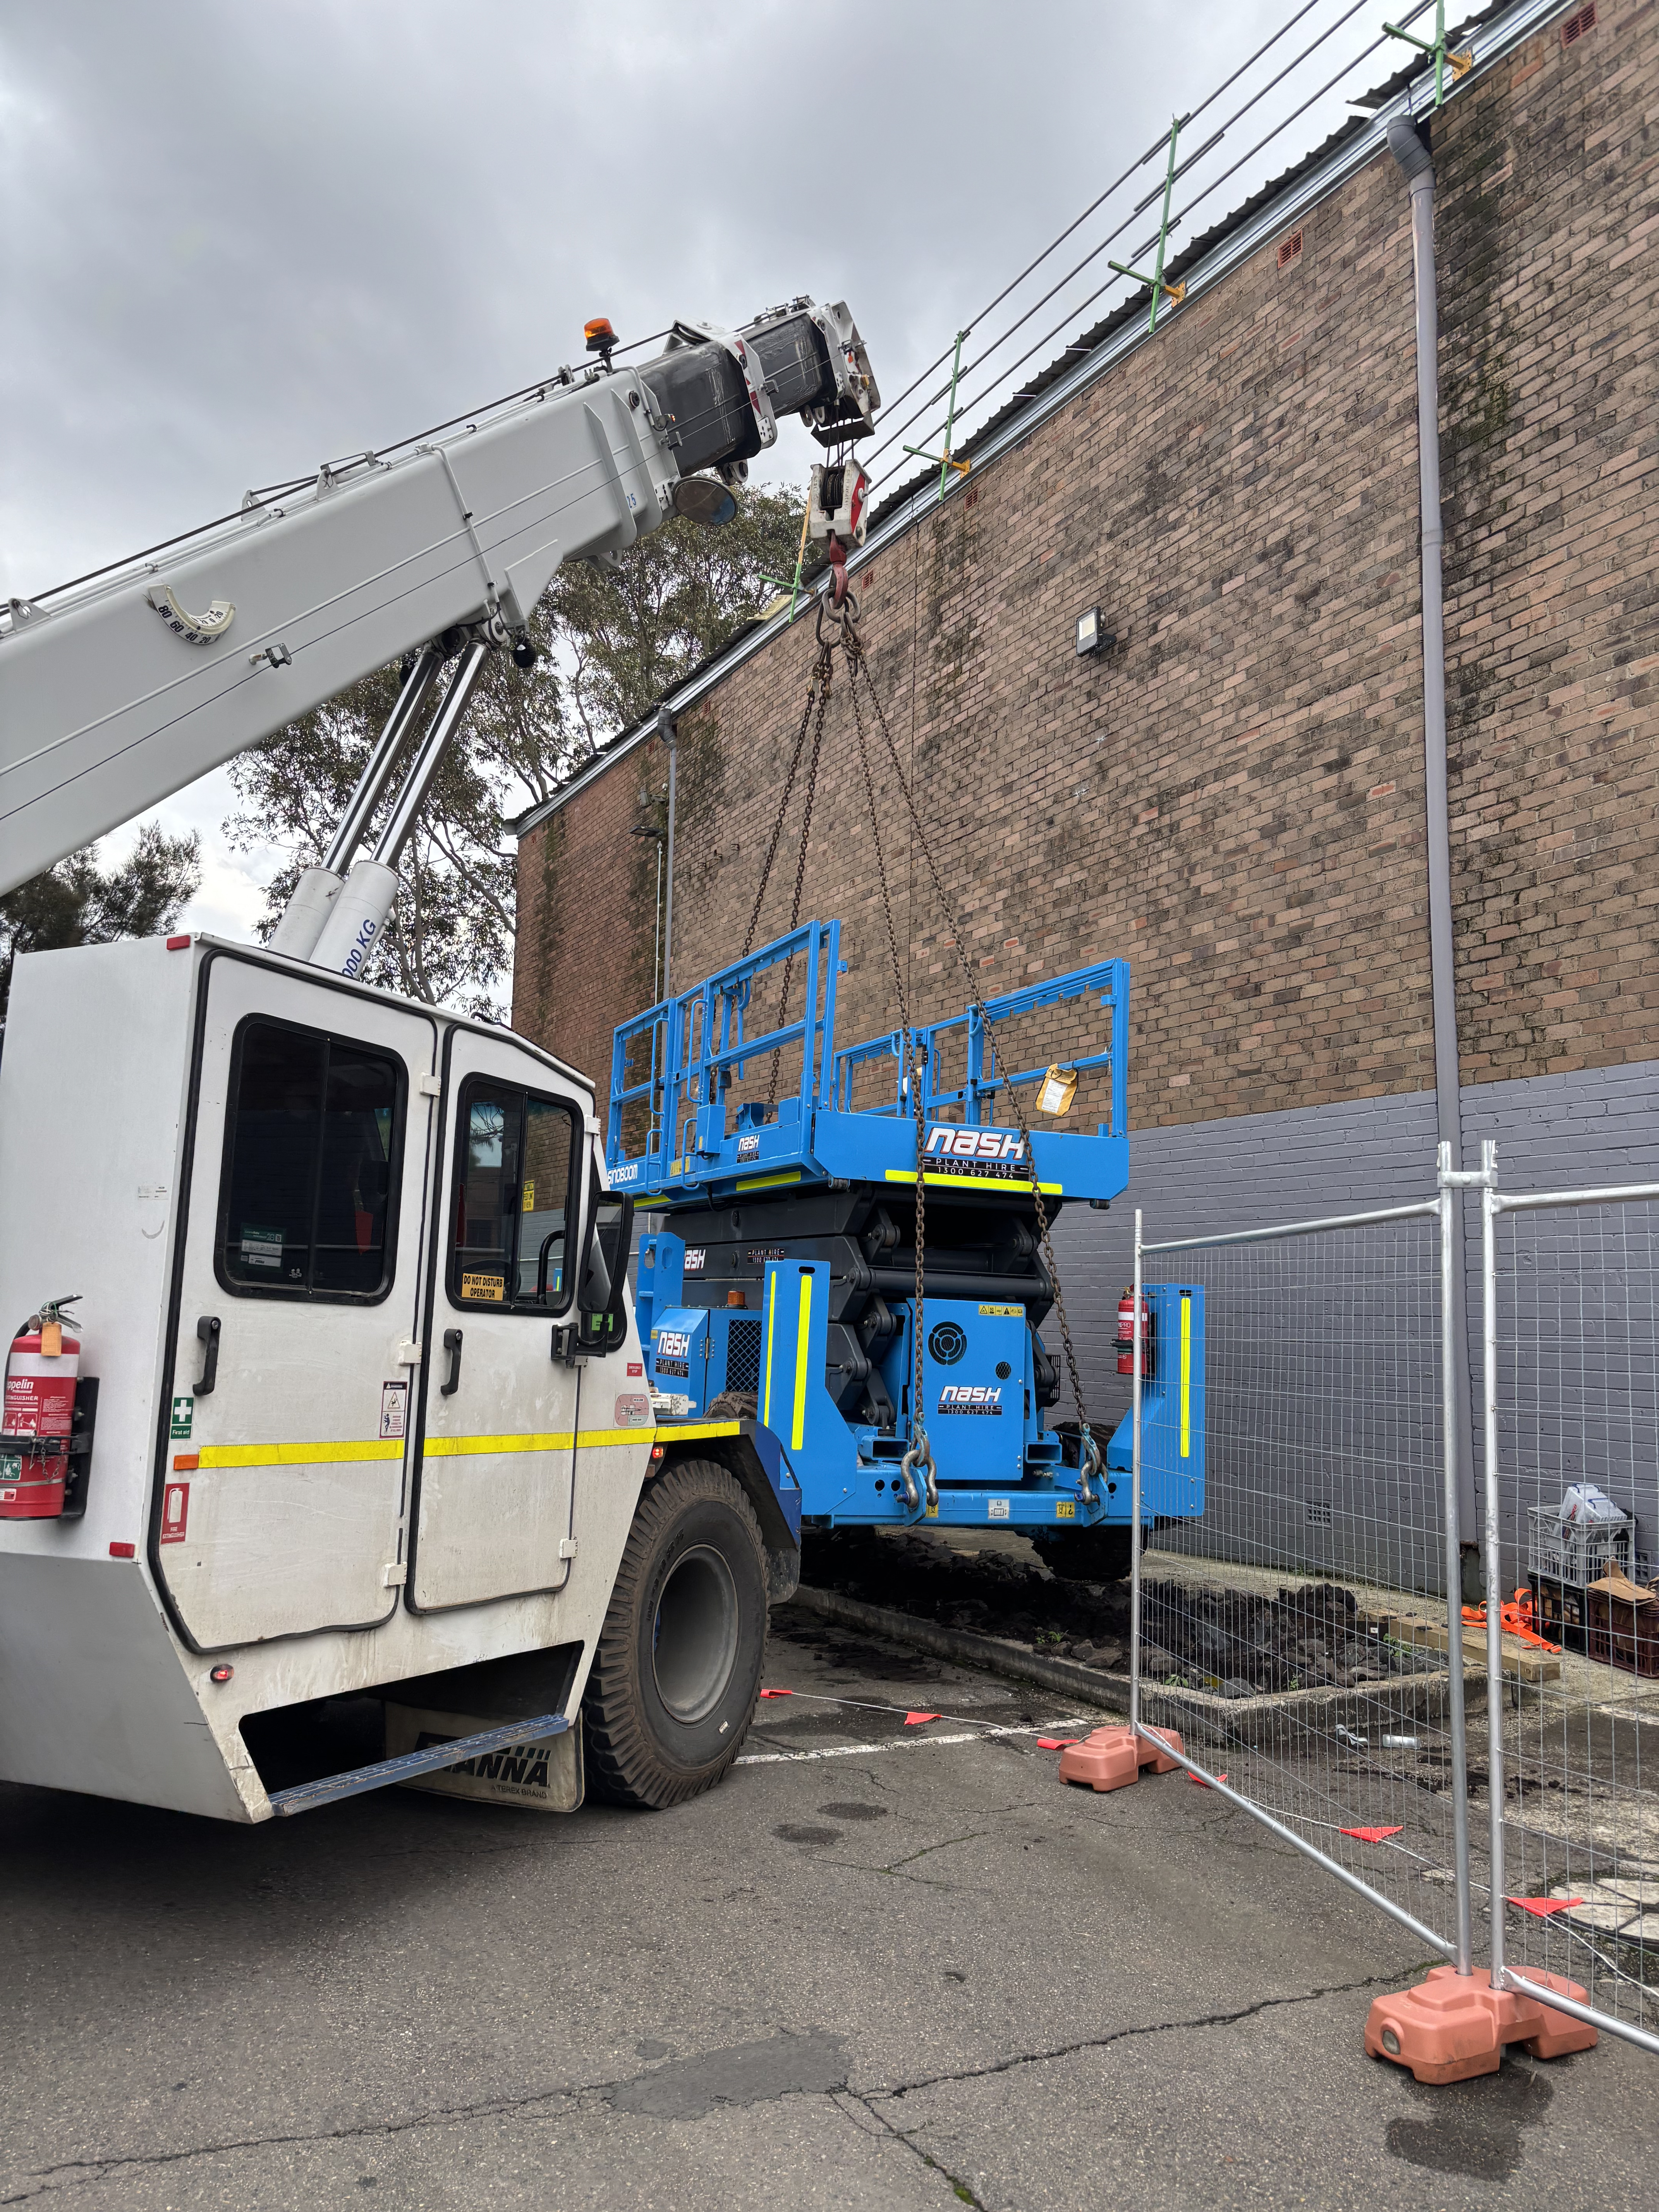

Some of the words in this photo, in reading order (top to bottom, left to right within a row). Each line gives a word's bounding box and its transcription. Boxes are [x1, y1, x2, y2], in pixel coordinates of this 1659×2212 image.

[158, 605, 172, 618] 80
[170, 620, 185, 632] 60
[185, 632, 199, 641] 40
[356, 919, 376, 950] KG
[936, 1158, 977, 1169] PLANT
[986, 1162, 1015, 1171] HIRE
[938, 1166, 964, 1175] 1300
[464, 1275, 471, 1285] DO
[472, 1276, 482, 1286] NOT
[483, 1277, 503, 1288] DISTURB
[470, 1287, 495, 1298] OPERATOR
[497, 1785, 520, 1795] TEREX
[521, 1789, 547, 1799] BRAND
